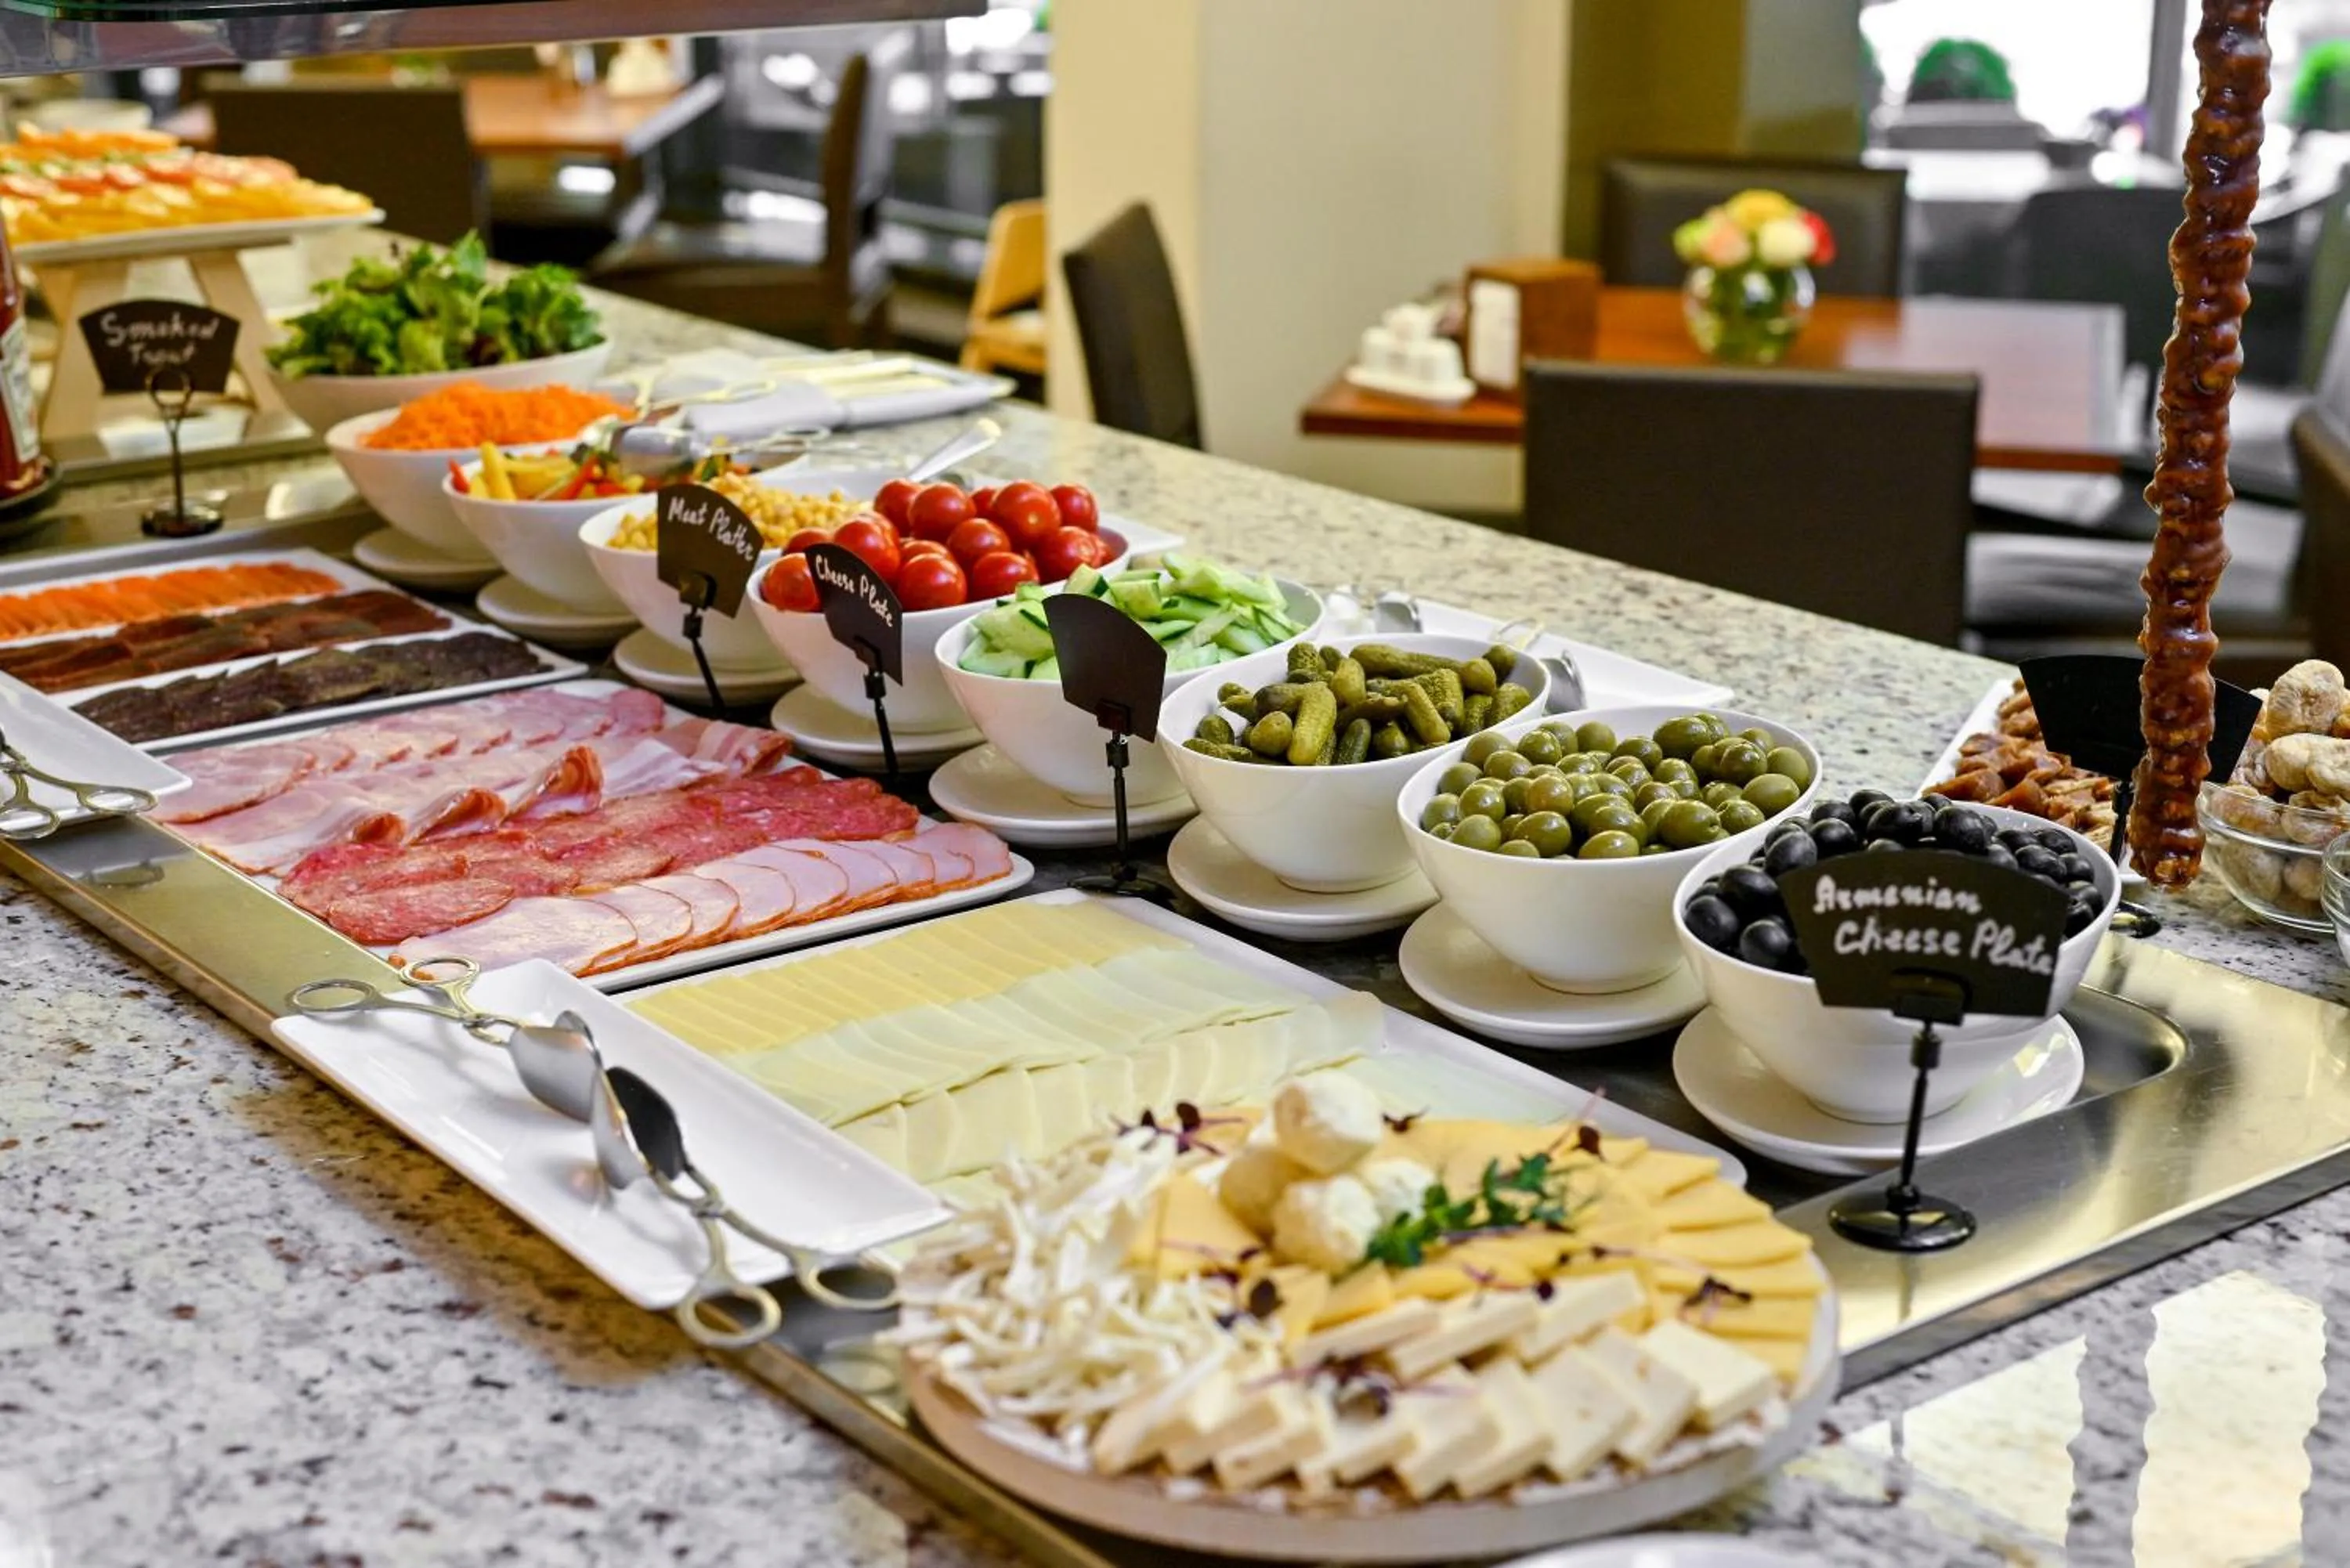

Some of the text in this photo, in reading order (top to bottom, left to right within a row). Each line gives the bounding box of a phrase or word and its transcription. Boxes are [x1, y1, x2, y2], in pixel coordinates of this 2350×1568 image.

[99, 312, 219, 347] Smoked
[668, 497, 707, 526] Meat
[815, 555, 894, 627] Cheese Plate
[1813, 874, 1983, 915] Armenian
[1834, 915, 2054, 975] Cheese Plate
